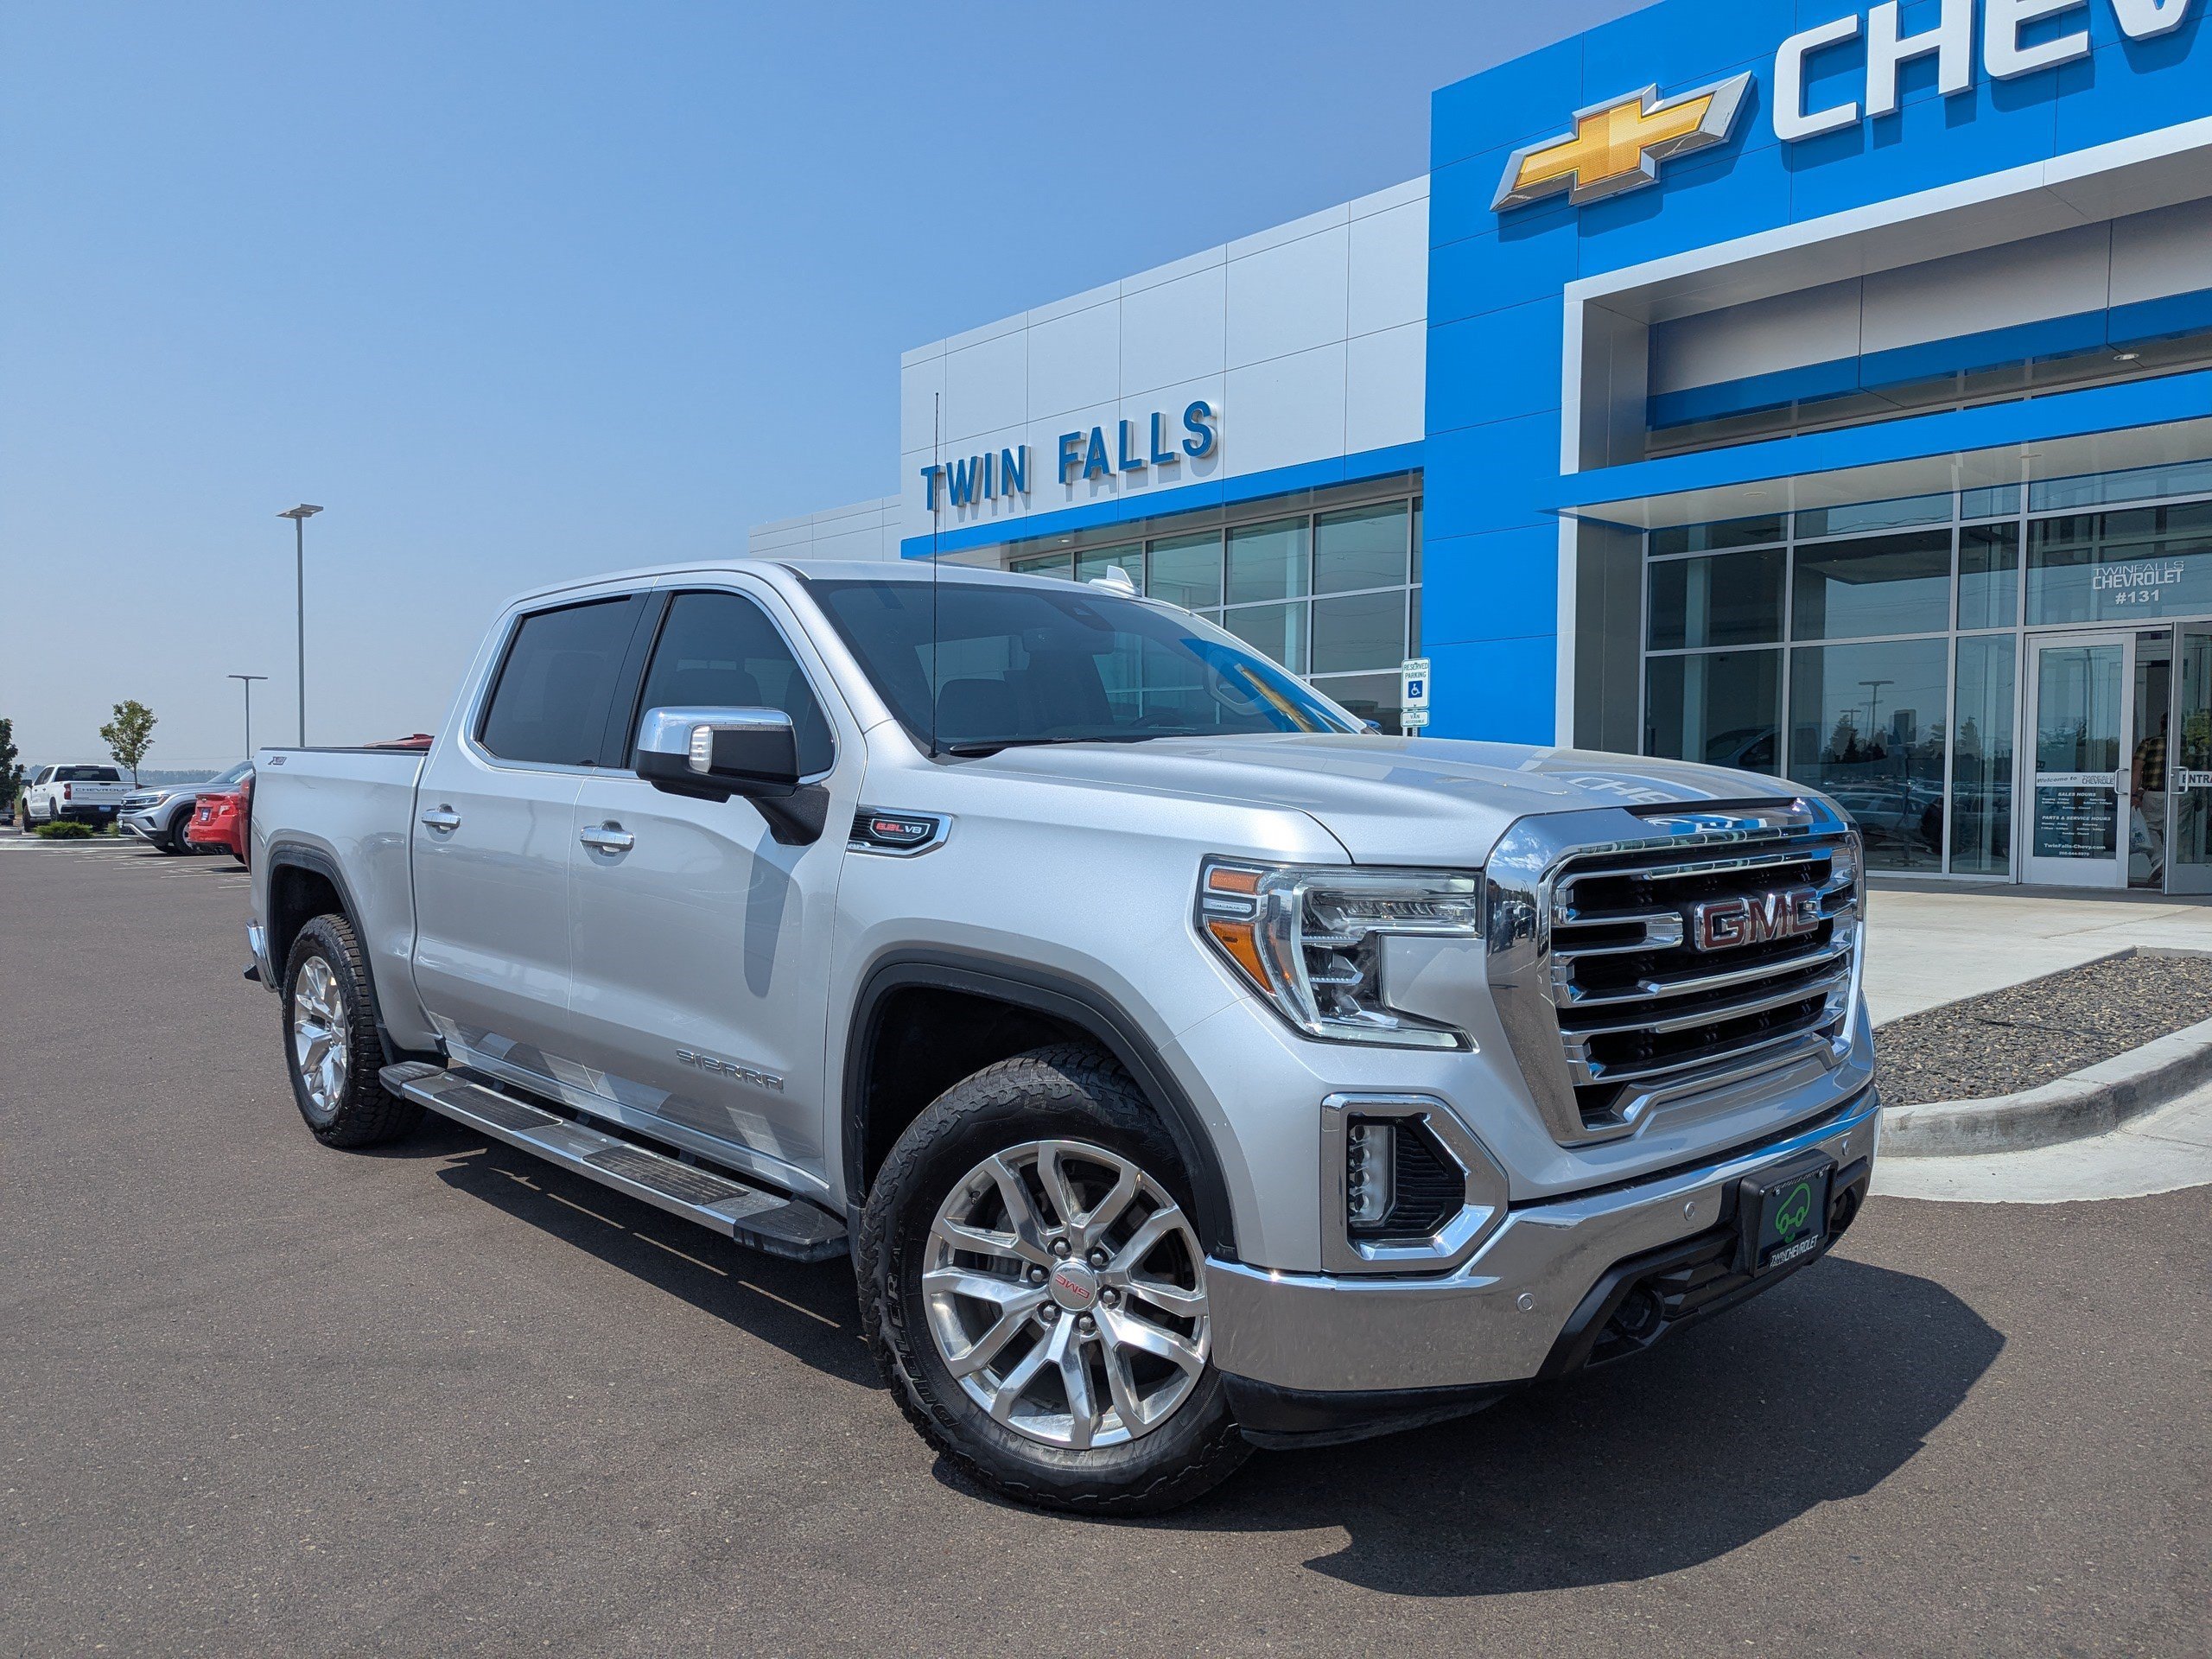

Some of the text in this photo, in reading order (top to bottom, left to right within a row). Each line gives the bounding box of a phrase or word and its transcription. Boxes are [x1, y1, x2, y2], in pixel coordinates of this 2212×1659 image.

[920, 400, 1217, 512] TWIN FALLS
[2092, 569, 2184, 589] CHEVROLET
[2115, 588, 2159, 604] #131
[1403, 662, 1428, 671] RESERVED
[2182, 774, 2212, 784] ENTR
[905, 825, 922, 834] V8
[1699, 889, 1820, 950] GMC
[676, 1048, 784, 1091] SIERRA
[1783, 1234, 1819, 1262] CHEVROLET
[1055, 1273, 1090, 1299] GMC
